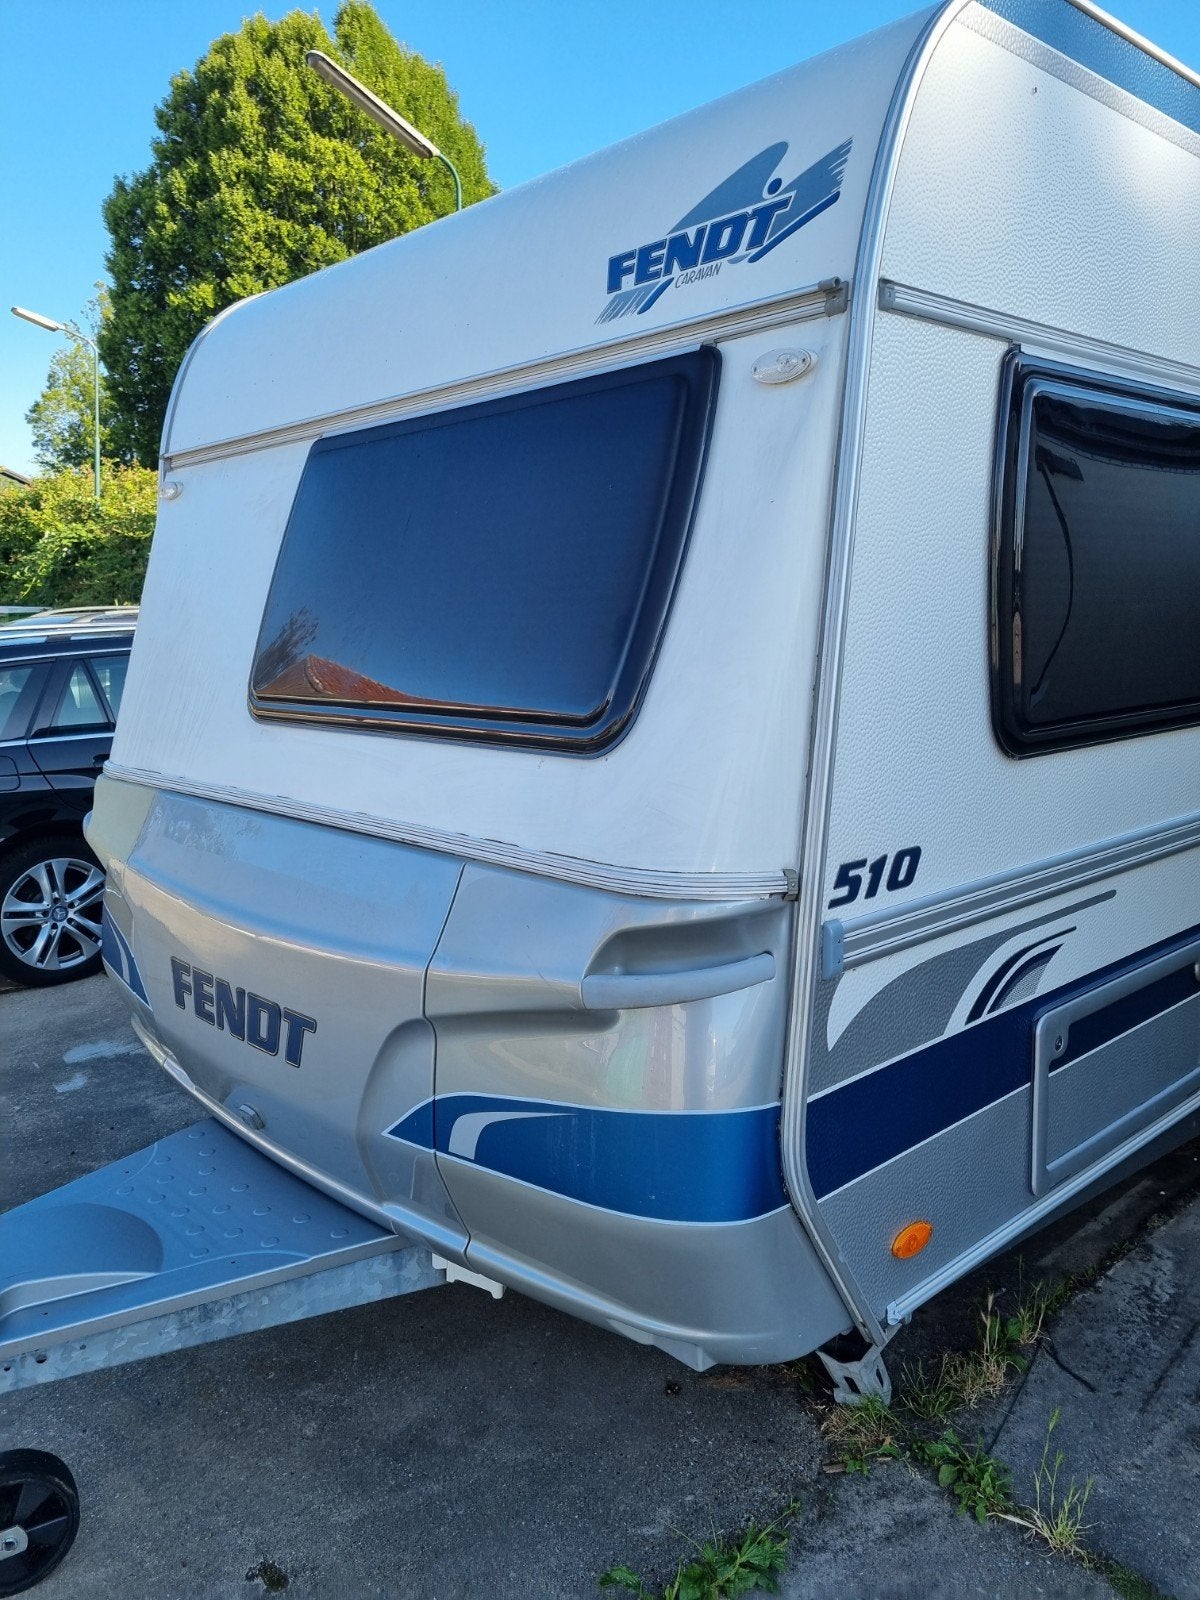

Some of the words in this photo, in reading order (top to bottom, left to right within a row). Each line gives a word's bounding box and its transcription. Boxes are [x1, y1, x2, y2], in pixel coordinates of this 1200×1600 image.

[607, 195, 795, 294] FENDT
[674, 262, 723, 289] CARAVAN
[828, 845, 922, 910] 510
[170, 956, 318, 1069] FENDT
